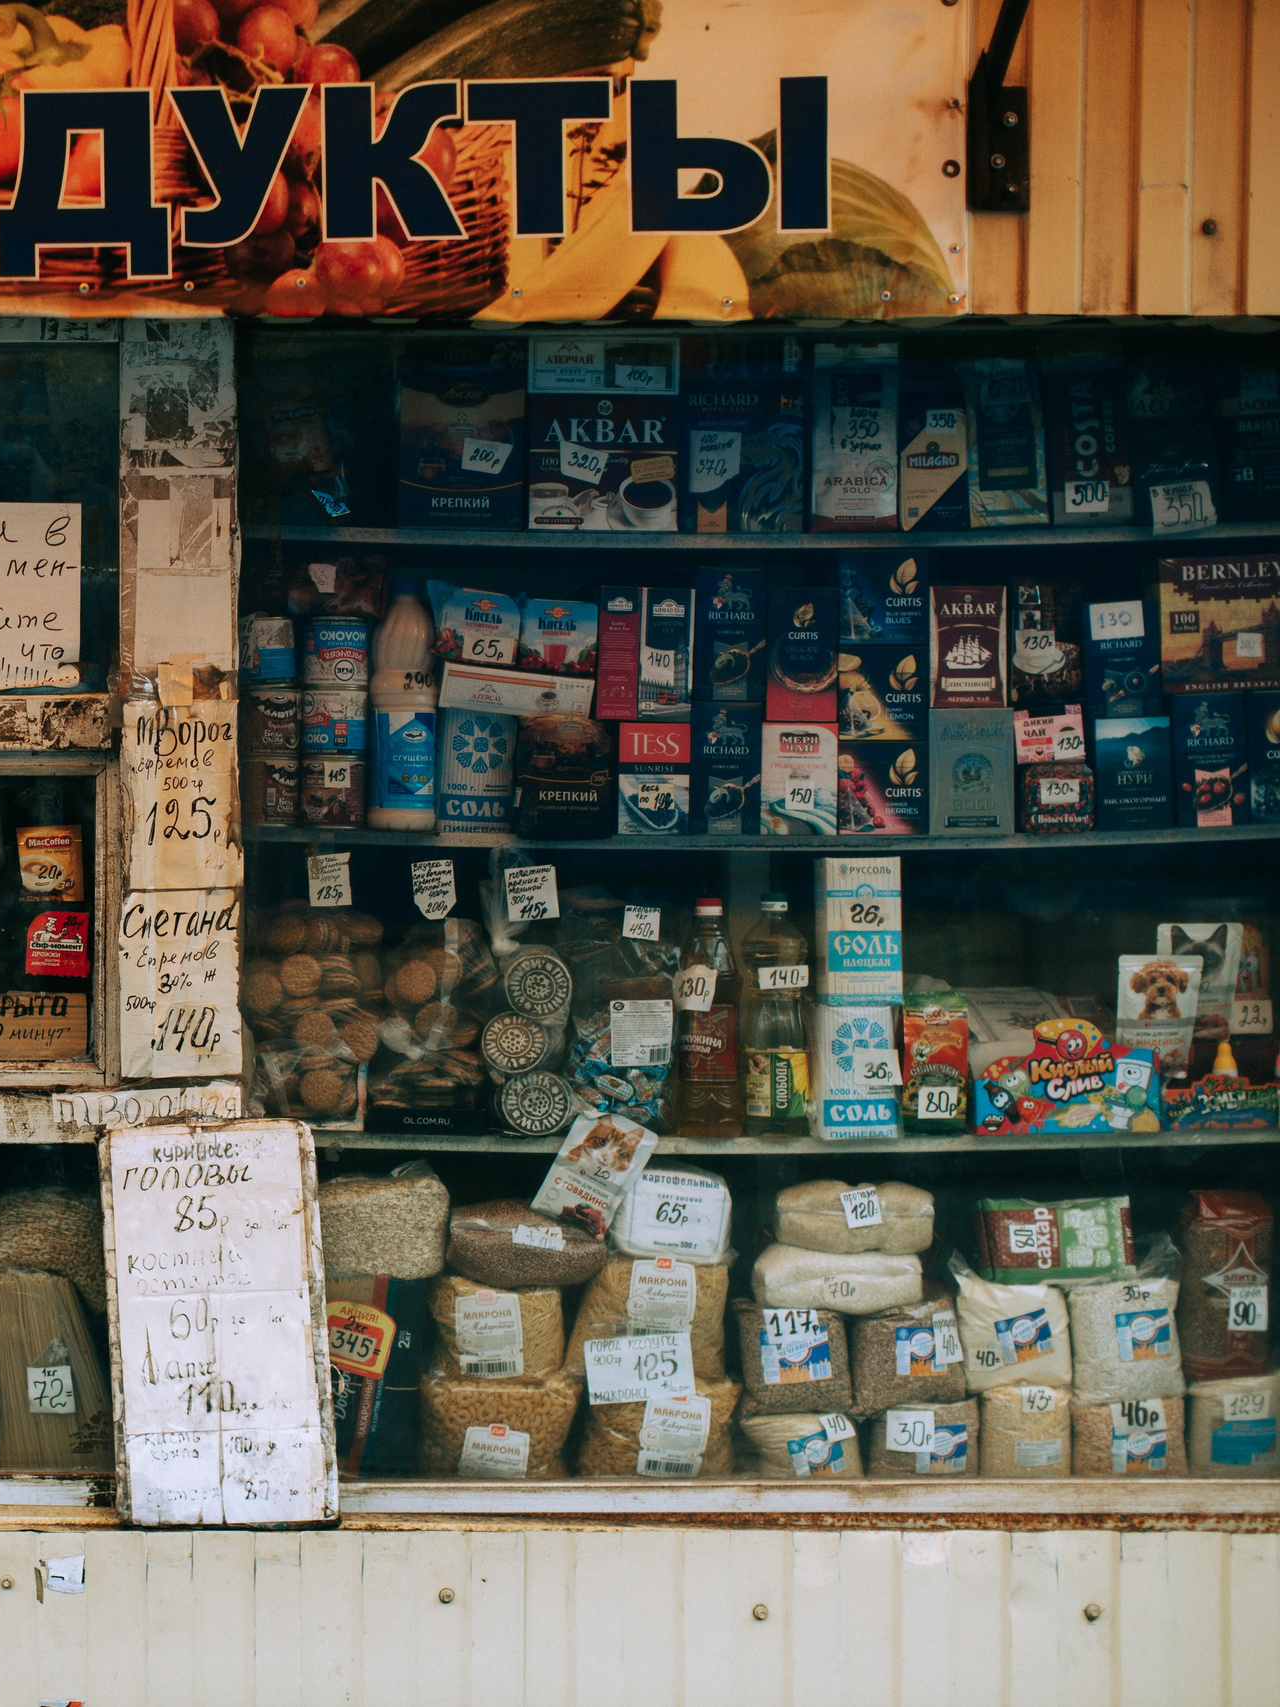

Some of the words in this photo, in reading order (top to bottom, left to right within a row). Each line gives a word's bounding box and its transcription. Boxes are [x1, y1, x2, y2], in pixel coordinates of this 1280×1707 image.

[546, 354, 593, 365] АЗЕРЧАЙ
[688, 394, 758, 407] RICHARD
[543, 418, 666, 444] AKBAR
[845, 420, 879, 439] 350
[909, 454, 957, 467] MILAGRO
[824, 476, 888, 487] ARABICA
[843, 486, 870, 494] SOLO
[431, 496, 490, 509] КРЕПКИЙ
[885, 597, 922, 607] CURTIS
[939, 602, 997, 615] AKBAR
[708, 611, 755, 621] RICHARD
[885, 616, 912, 624] BLUES
[1174, 612, 1196, 625] 100
[788, 631, 818, 640] CURTIS
[1185, 682, 1230, 691] ENGLISH
[885, 693, 921, 703] CURTIS
[1023, 728, 1047, 738] ЧАЙ
[628, 732, 680, 757] TESS
[703, 745, 750, 756] RICHARD
[634, 765, 675, 773] SUNRISE
[1117, 771, 1153, 785] НУРИ
[446, 783, 466, 791] 1000
[885, 787, 922, 797] CURTIS
[539, 789, 598, 803] КРЕПКИЙ
[788, 786, 812, 805] 150
[445, 799, 506, 818] СОЛЬ
[885, 807, 919, 815] BERRIES
[28, 837, 70, 847] MacCoffee
[848, 866, 892, 875] РУССОЛЬ
[850, 903, 884, 925] 26р
[833, 934, 899, 956] СОЛЬ
[843, 957, 891, 967] ИЛЕЦКАЯ
[863, 1061, 893, 1080] 36р
[1030, 1053, 1115, 1083] Кислый
[775, 1059, 789, 1109] СЛОБОДА
[1046, 1076, 1104, 1102] Слив
[829, 1088, 849, 1096] 1000
[925, 1090, 957, 1116] 80р
[830, 1104, 892, 1121] СОЛЬ
[403, 1116, 451, 1126] OL.COM.RU
[829, 1129, 894, 1138] ПИЩЕВАЯ
[642, 1171, 720, 1190] картофельный
[655, 1201, 689, 1226] 65р
[1035, 1206, 1053, 1270] сахар
[638, 1275, 688, 1288] МАКРОНА
[339, 1304, 379, 1324] АКЦИЯ!
[462, 1309, 513, 1320] МАКРОНА
[634, 1349, 679, 1382] 125
[652, 1406, 703, 1421] МАКРОНА
[471, 1441, 520, 1456] МАКРОНА
